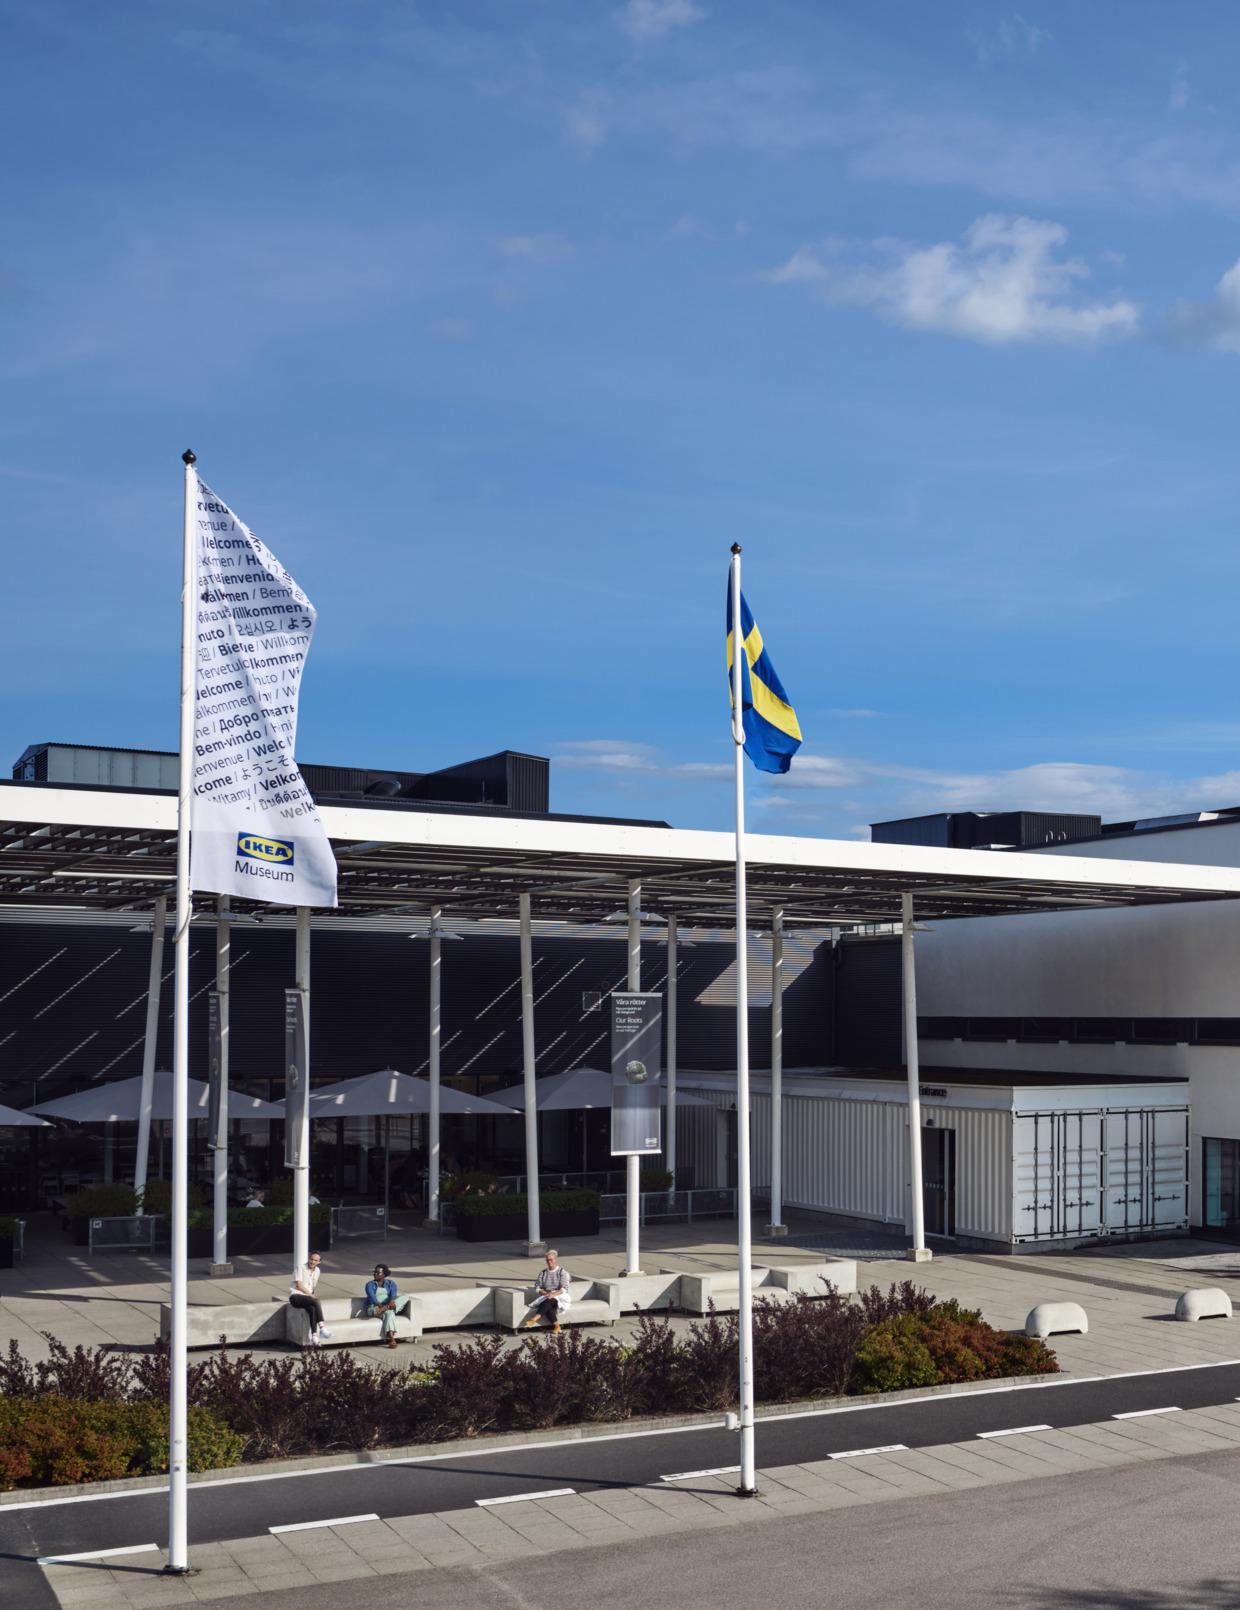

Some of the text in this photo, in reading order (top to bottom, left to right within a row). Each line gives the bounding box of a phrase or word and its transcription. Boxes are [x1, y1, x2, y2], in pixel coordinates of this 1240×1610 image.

[219, 712, 260, 734] Добро
[195, 730, 262, 757] Bem-vindo
[241, 755, 289, 780] ようこそ
[245, 840, 289, 857] IKEA
[235, 860, 294, 882] Museum
